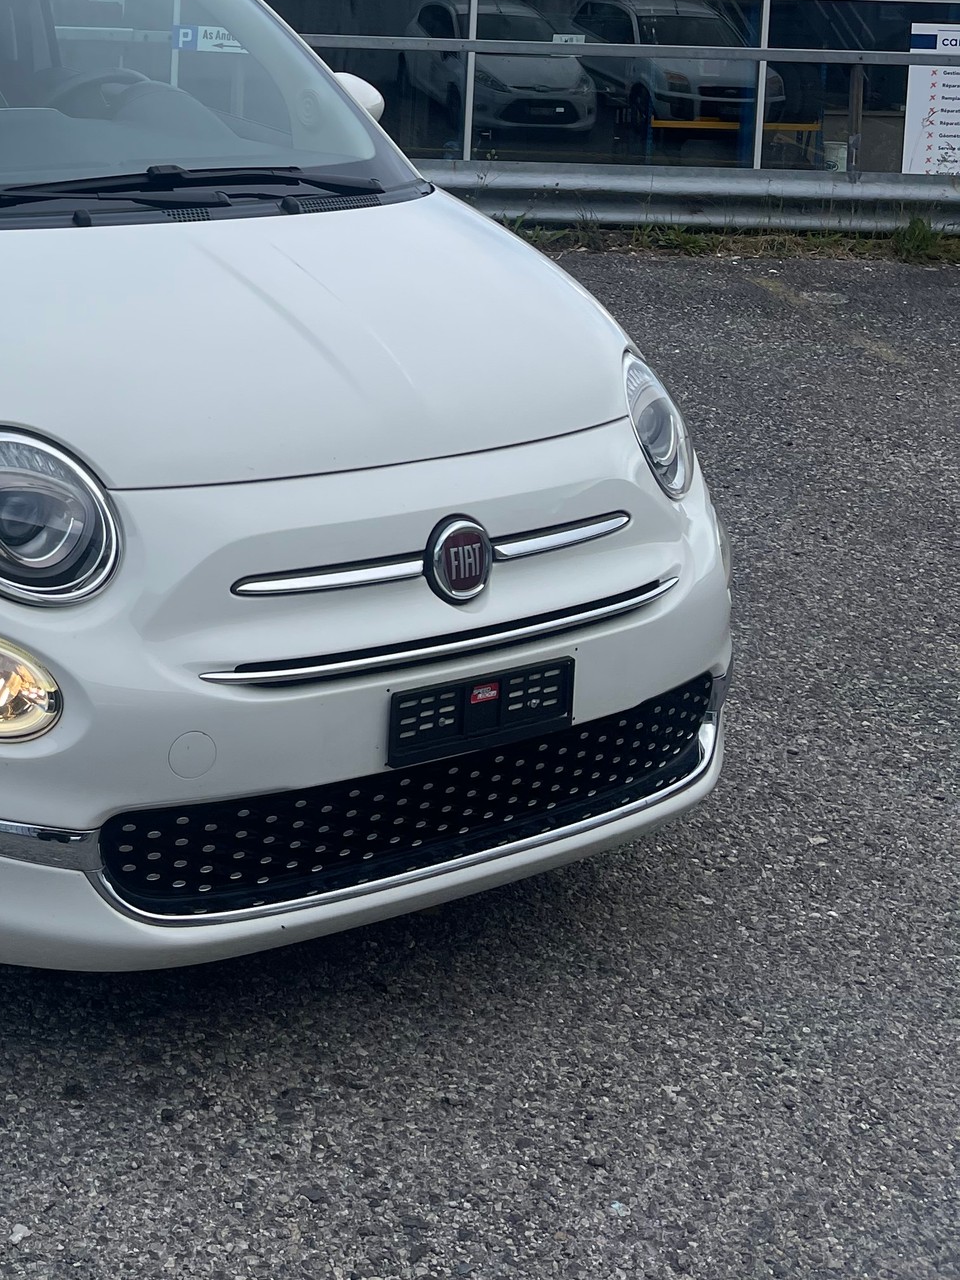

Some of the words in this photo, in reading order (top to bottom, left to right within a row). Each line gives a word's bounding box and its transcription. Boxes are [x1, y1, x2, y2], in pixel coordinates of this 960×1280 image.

[178, 28, 192, 48] P
[203, 29, 213, 40] As
[450, 543, 480, 580] FIAT
